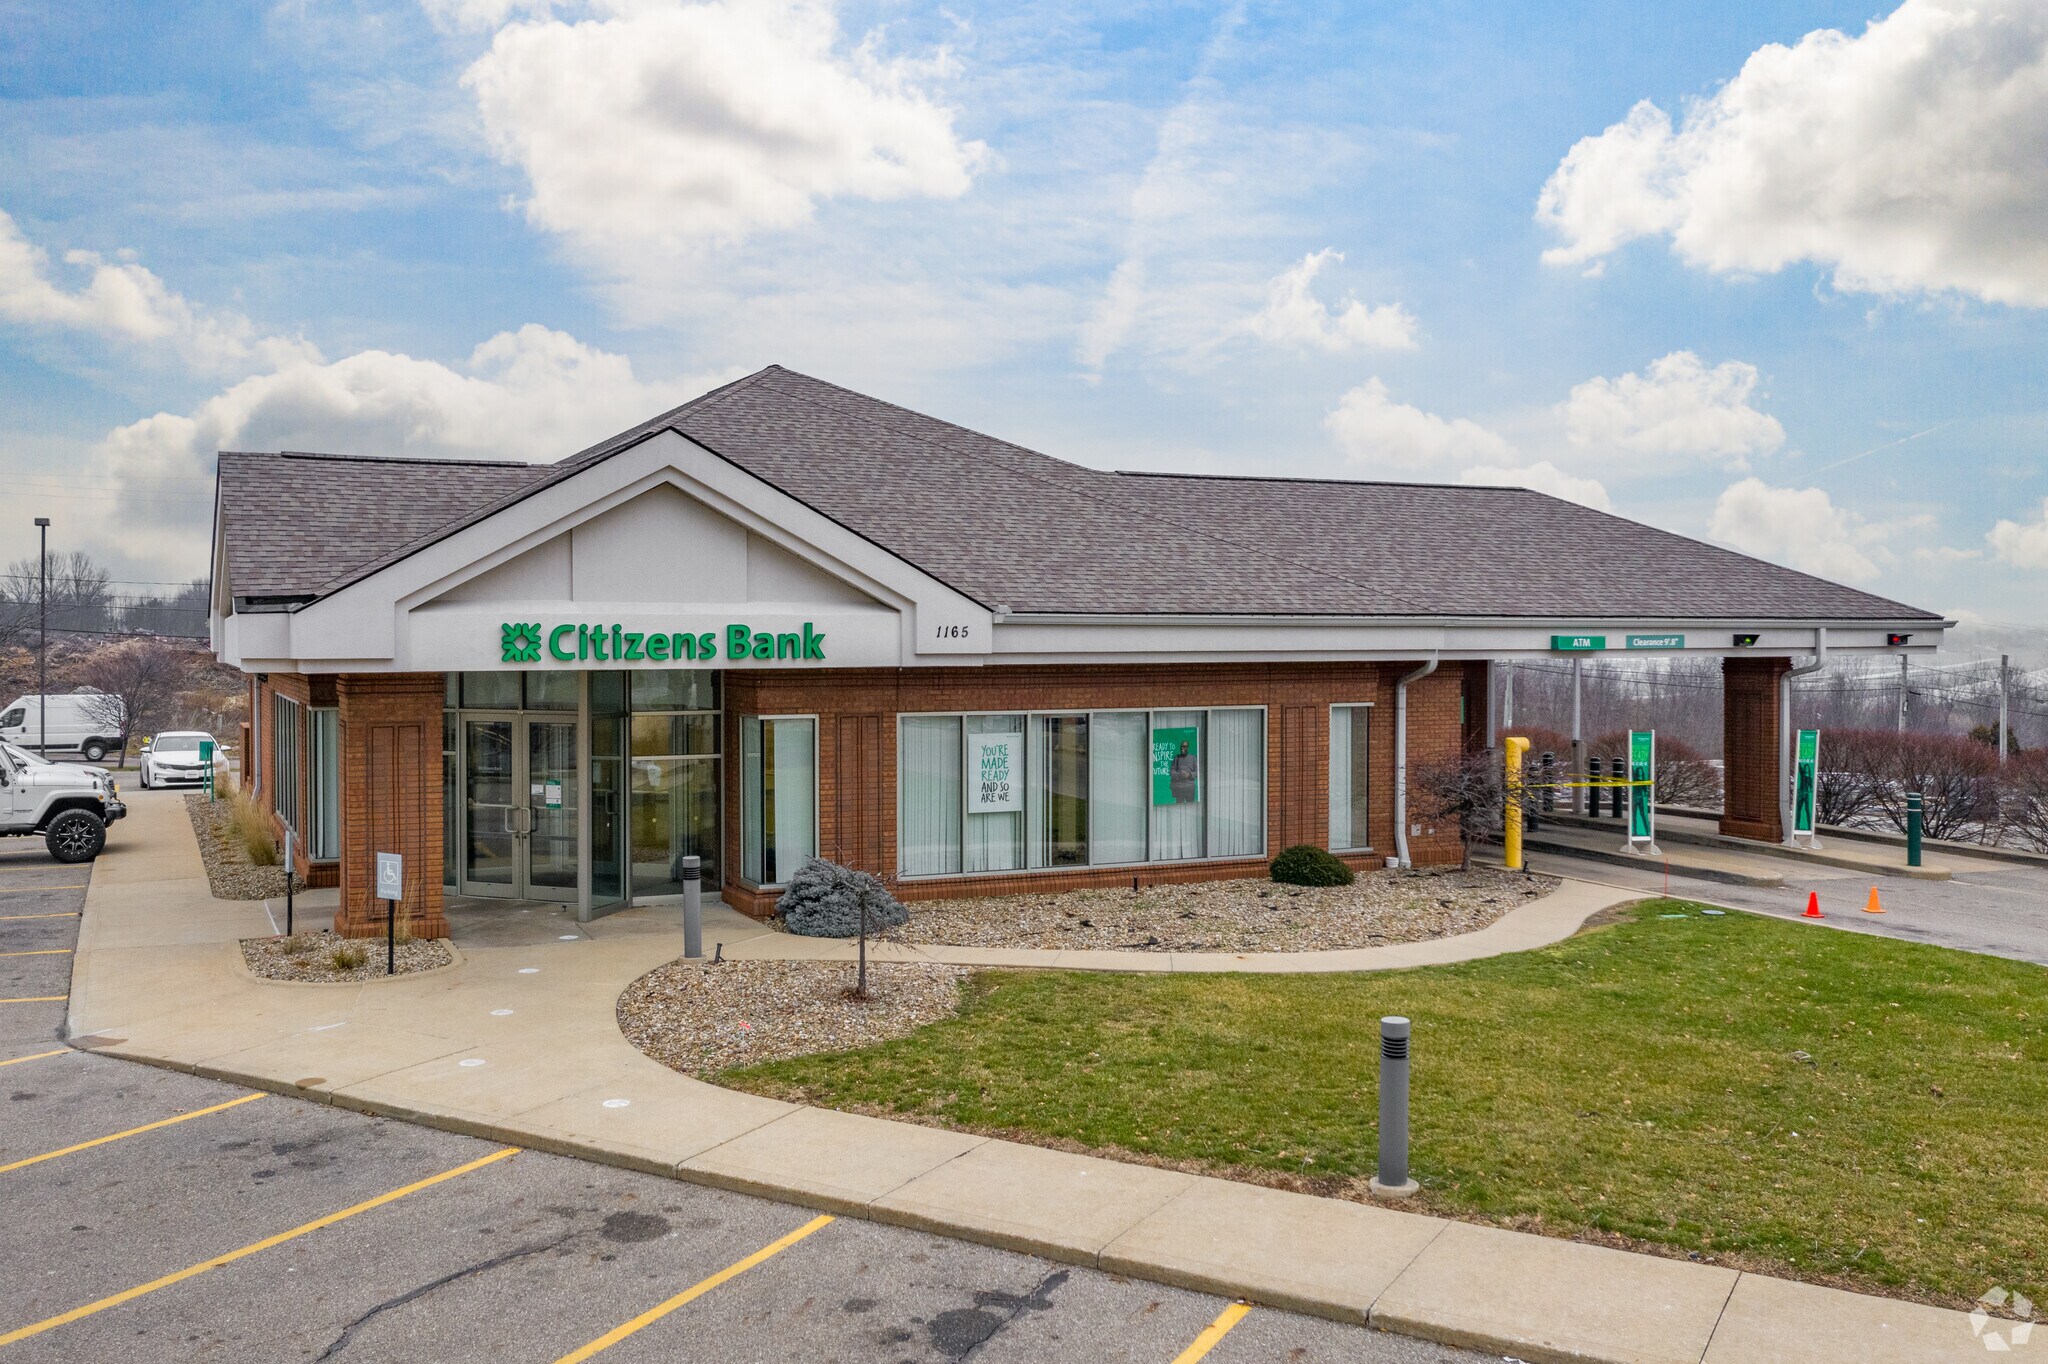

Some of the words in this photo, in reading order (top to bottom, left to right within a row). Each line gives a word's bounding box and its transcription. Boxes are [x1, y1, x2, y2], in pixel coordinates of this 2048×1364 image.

[936, 625, 969, 638] 1165
[550, 623, 717, 661] Citizens
[726, 622, 826, 660] Bank
[1572, 638, 1591, 647] ATM
[1633, 638, 1664, 646] Clearance
[981, 744, 1008, 757] YOU'RE
[1170, 742, 1175, 750] TO
[1153, 750, 1174, 762] NSPIRE
[981, 757, 1008, 769] MADE
[981, 769, 1009, 781] READY
[981, 782, 998, 792] AND
[1000, 781, 1009, 791] SO
[980, 793, 996, 803] ARE
[998, 792, 1009, 801] WE
